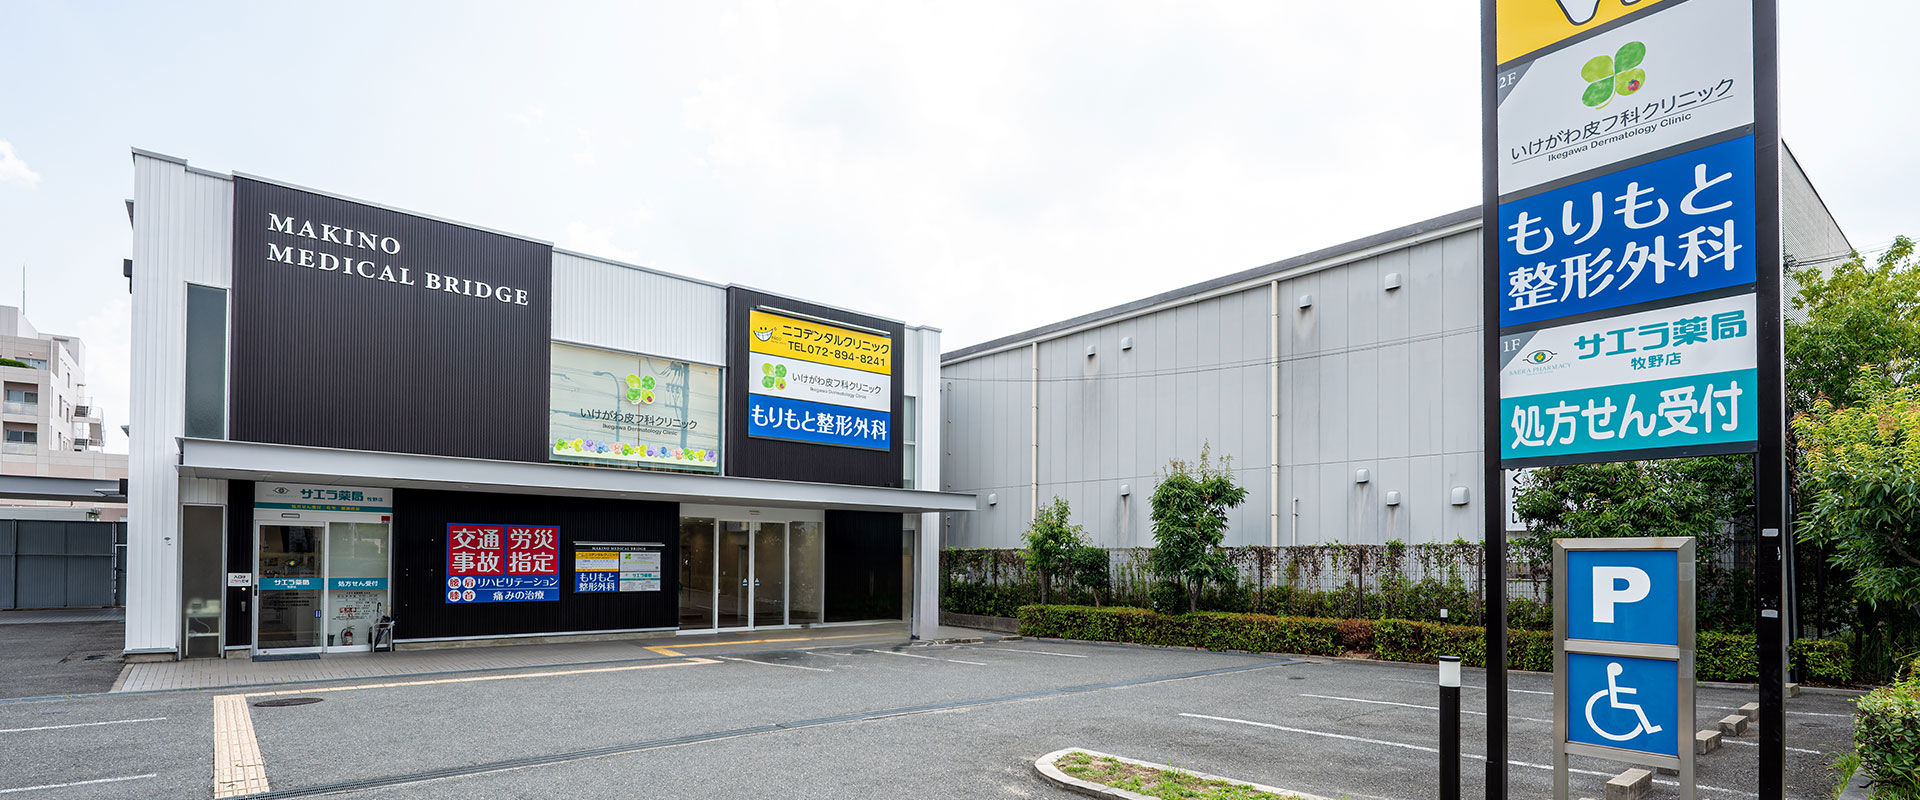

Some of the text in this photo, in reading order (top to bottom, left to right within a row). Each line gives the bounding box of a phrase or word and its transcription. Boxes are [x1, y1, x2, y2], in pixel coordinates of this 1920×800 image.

[1499, 72, 1517, 88] 2F
[1511, 78, 1734, 160] いけがわ皮フ科クリニック
[1548, 113, 1692, 162] Ikegawa Dermatology Clinic
[1507, 163, 1733, 255] もりもと
[267, 212, 401, 255] MAKINO
[266, 242, 529, 306] MEDICAL BRIDGE
[1508, 219, 1743, 312] 整形外科
[782, 325, 890, 355] ニコデンタルクリニック
[1503, 338, 1521, 353] 1F
[1573, 309, 1748, 361] サエラ薬局
[788, 340, 886, 367] TEL072-894-8241
[1630, 352, 1682, 370] 牧野店
[1532, 362, 1572, 374] PHARMACY
[792, 372, 882, 394] いけがわ皮フ科クリニック
[580, 408, 698, 430] いけがわ皮フ科クリニック
[751, 404, 888, 441] もりもと整形外科
[1511, 380, 1743, 449] 処方せん受付
[300, 488, 364, 502] サエラ薬局
[452, 527, 555, 550] 交通 労災
[452, 551, 501, 573] 事故
[509, 551, 555, 573] 指定
[478, 577, 558, 587] リハビリテーション
[580, 572, 615, 582] もりもと
[493, 590, 545, 601] 痛みの治療
[1592, 566, 1651, 623] P
